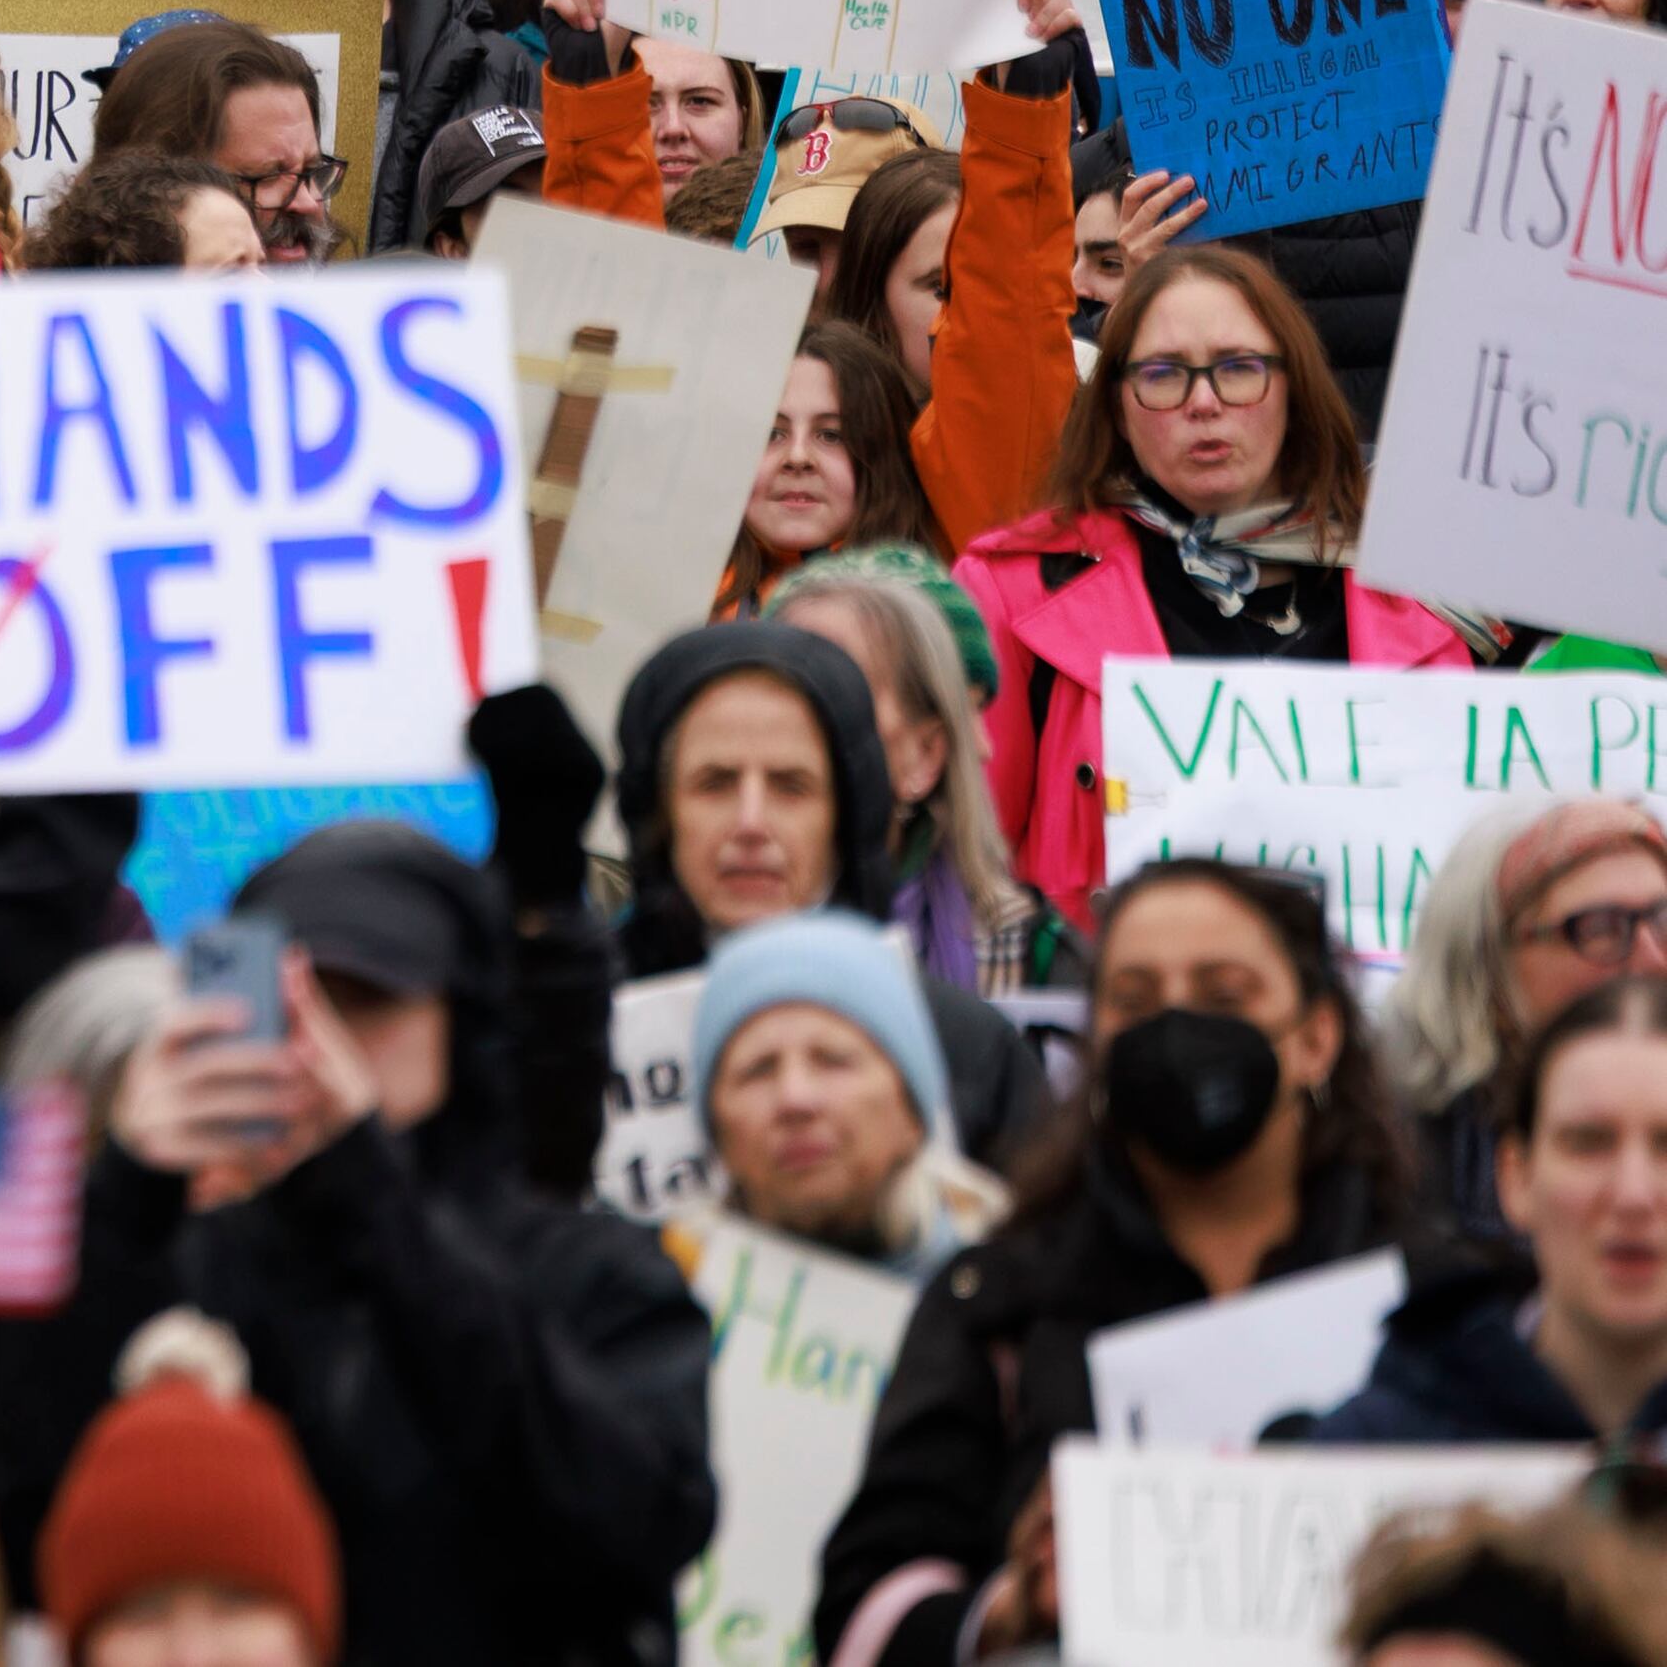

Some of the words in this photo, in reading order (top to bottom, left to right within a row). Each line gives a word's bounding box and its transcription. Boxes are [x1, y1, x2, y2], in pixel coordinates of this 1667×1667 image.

[1134, 83, 1198, 130] IS
[1228, 40, 1381, 105] ILLEGAL
[1206, 90, 1356, 156] PROTECT
[1464, 52, 1571, 250] It's
[1461, 345, 1558, 497] It's
